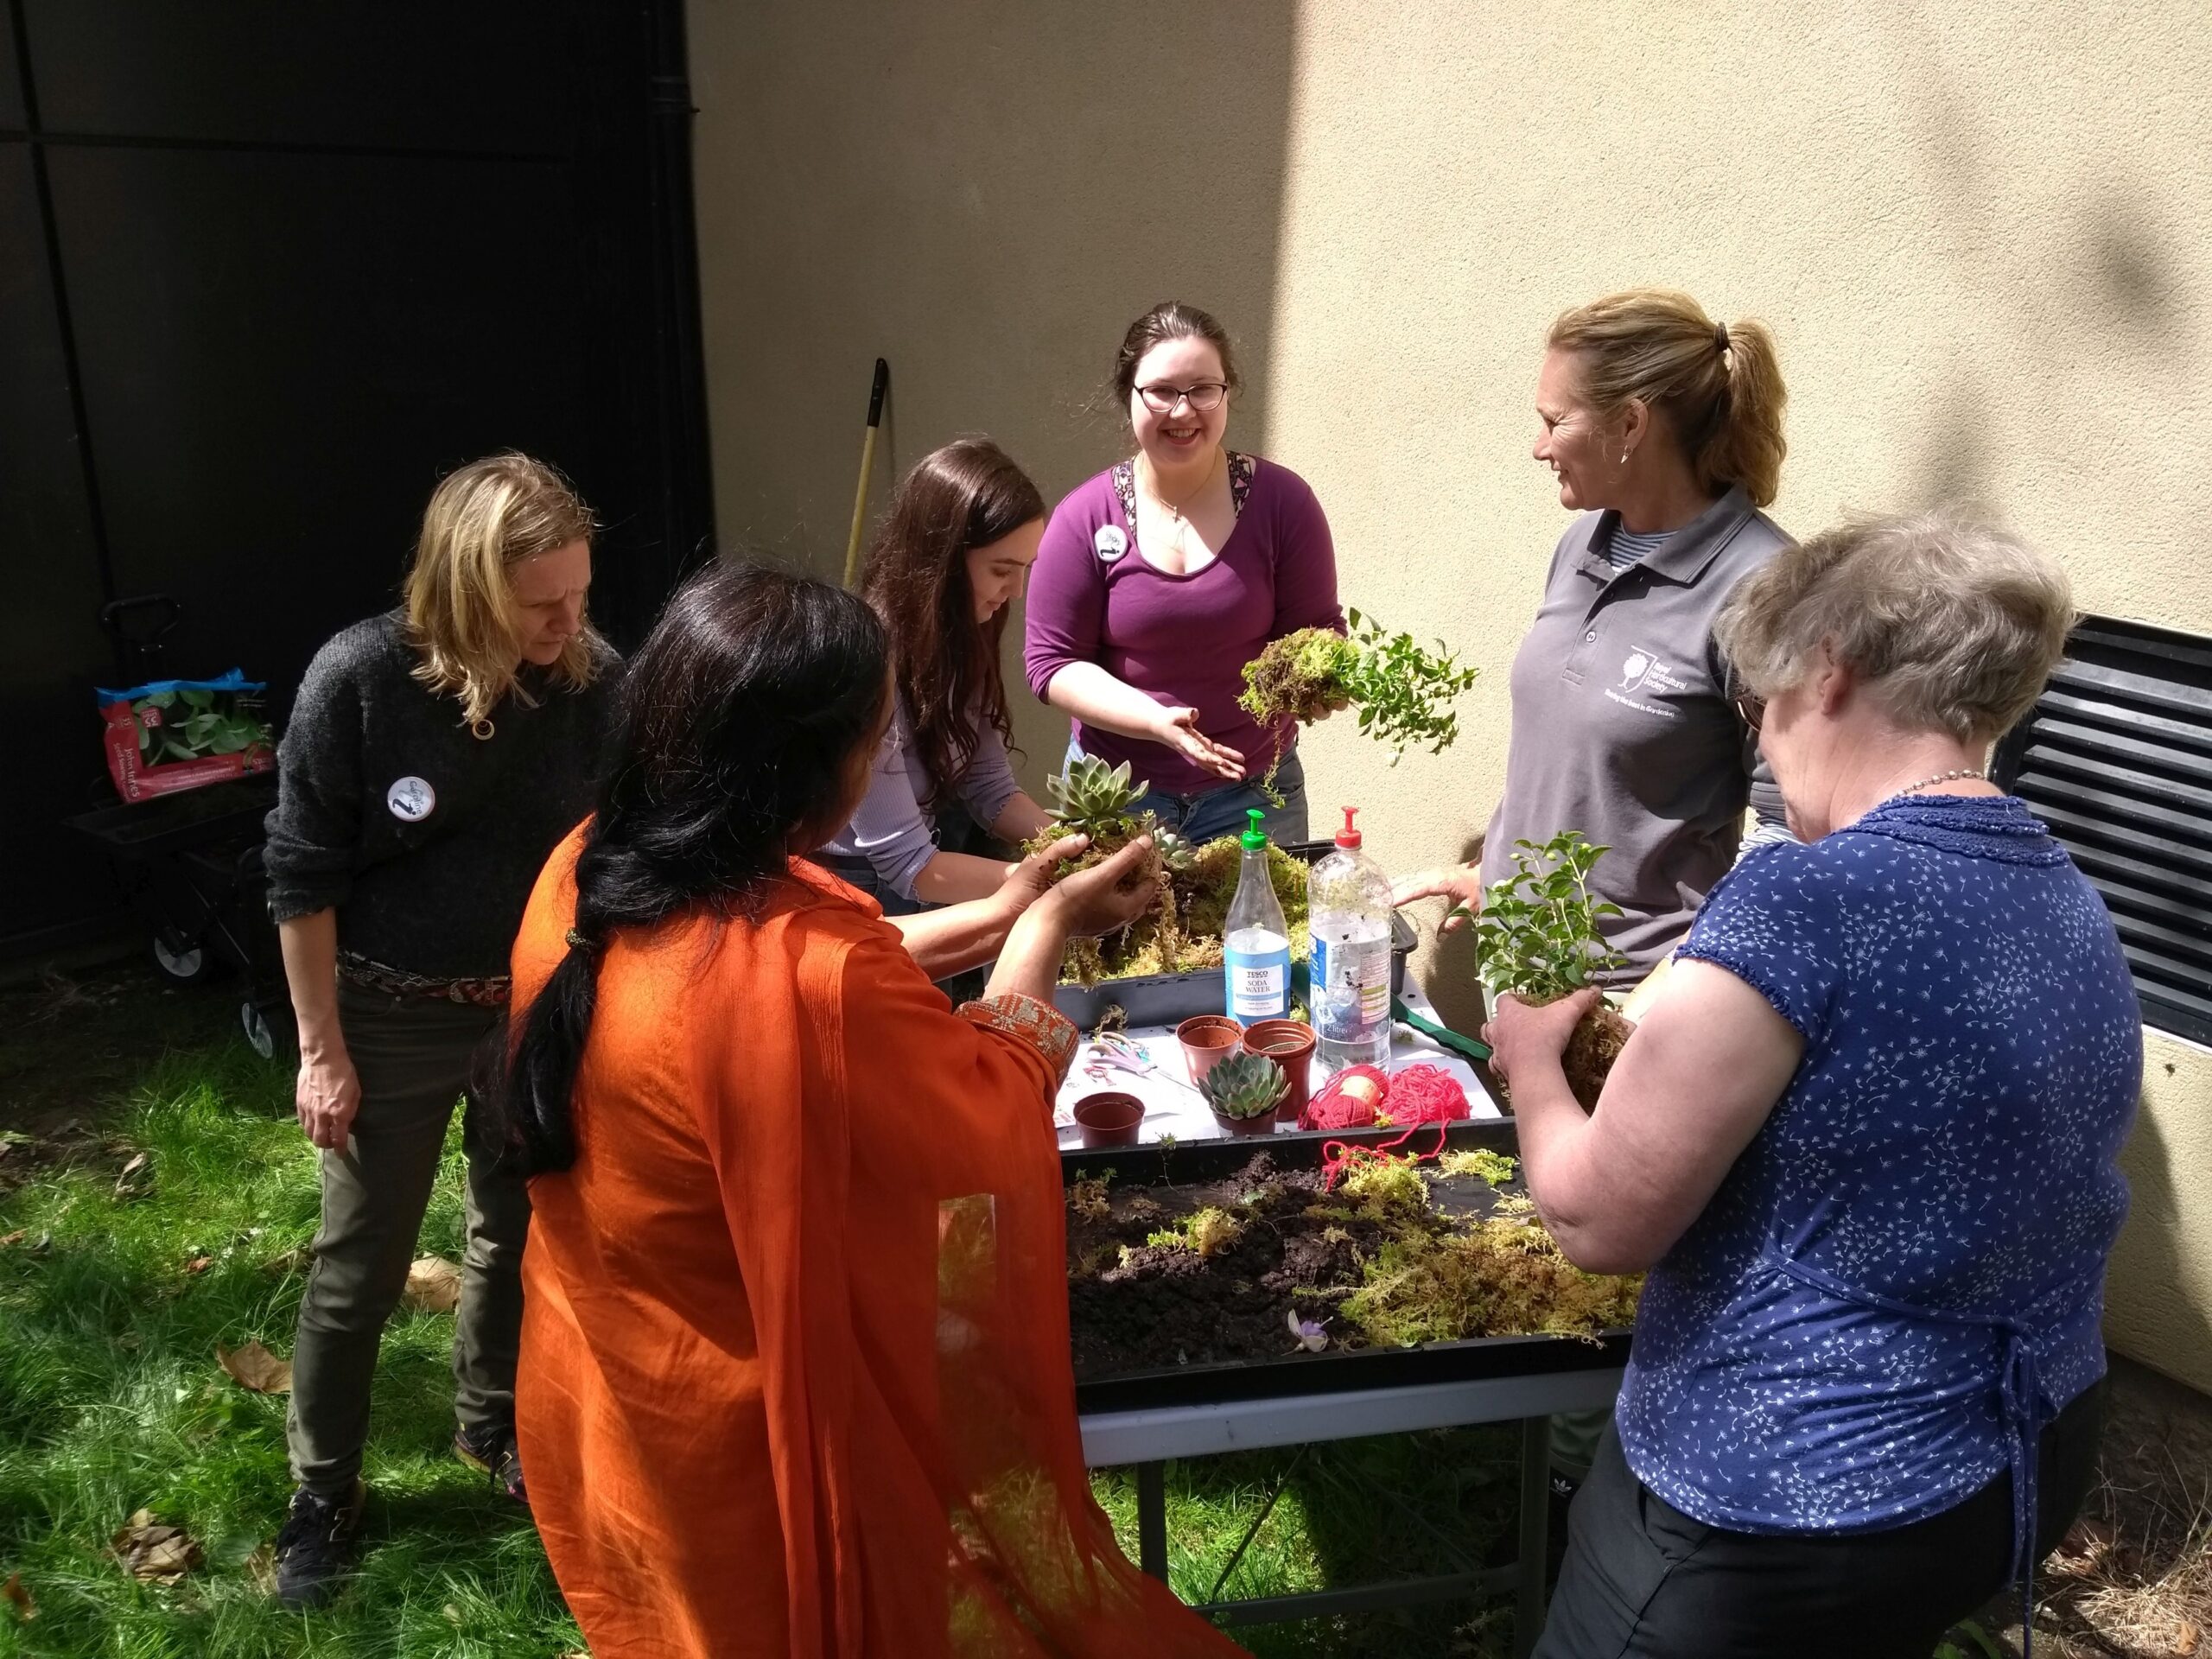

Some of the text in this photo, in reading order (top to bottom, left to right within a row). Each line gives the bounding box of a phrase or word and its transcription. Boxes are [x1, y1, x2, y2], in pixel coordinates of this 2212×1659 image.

[1653, 662, 1672, 674] Royal
[1643, 676, 1668, 695] Society
[1648, 669, 1688, 690] Horticultural
[1619, 696, 1629, 705] the
[1627, 698, 1641, 709] best
[1640, 702, 1646, 712] in
[1645, 705, 1675, 718] Gardening
[112, 742, 124, 758] Seed
[124, 747, 135, 770] John
[127, 770, 141, 798] Innes
[410, 780, 423, 815] Caroline
